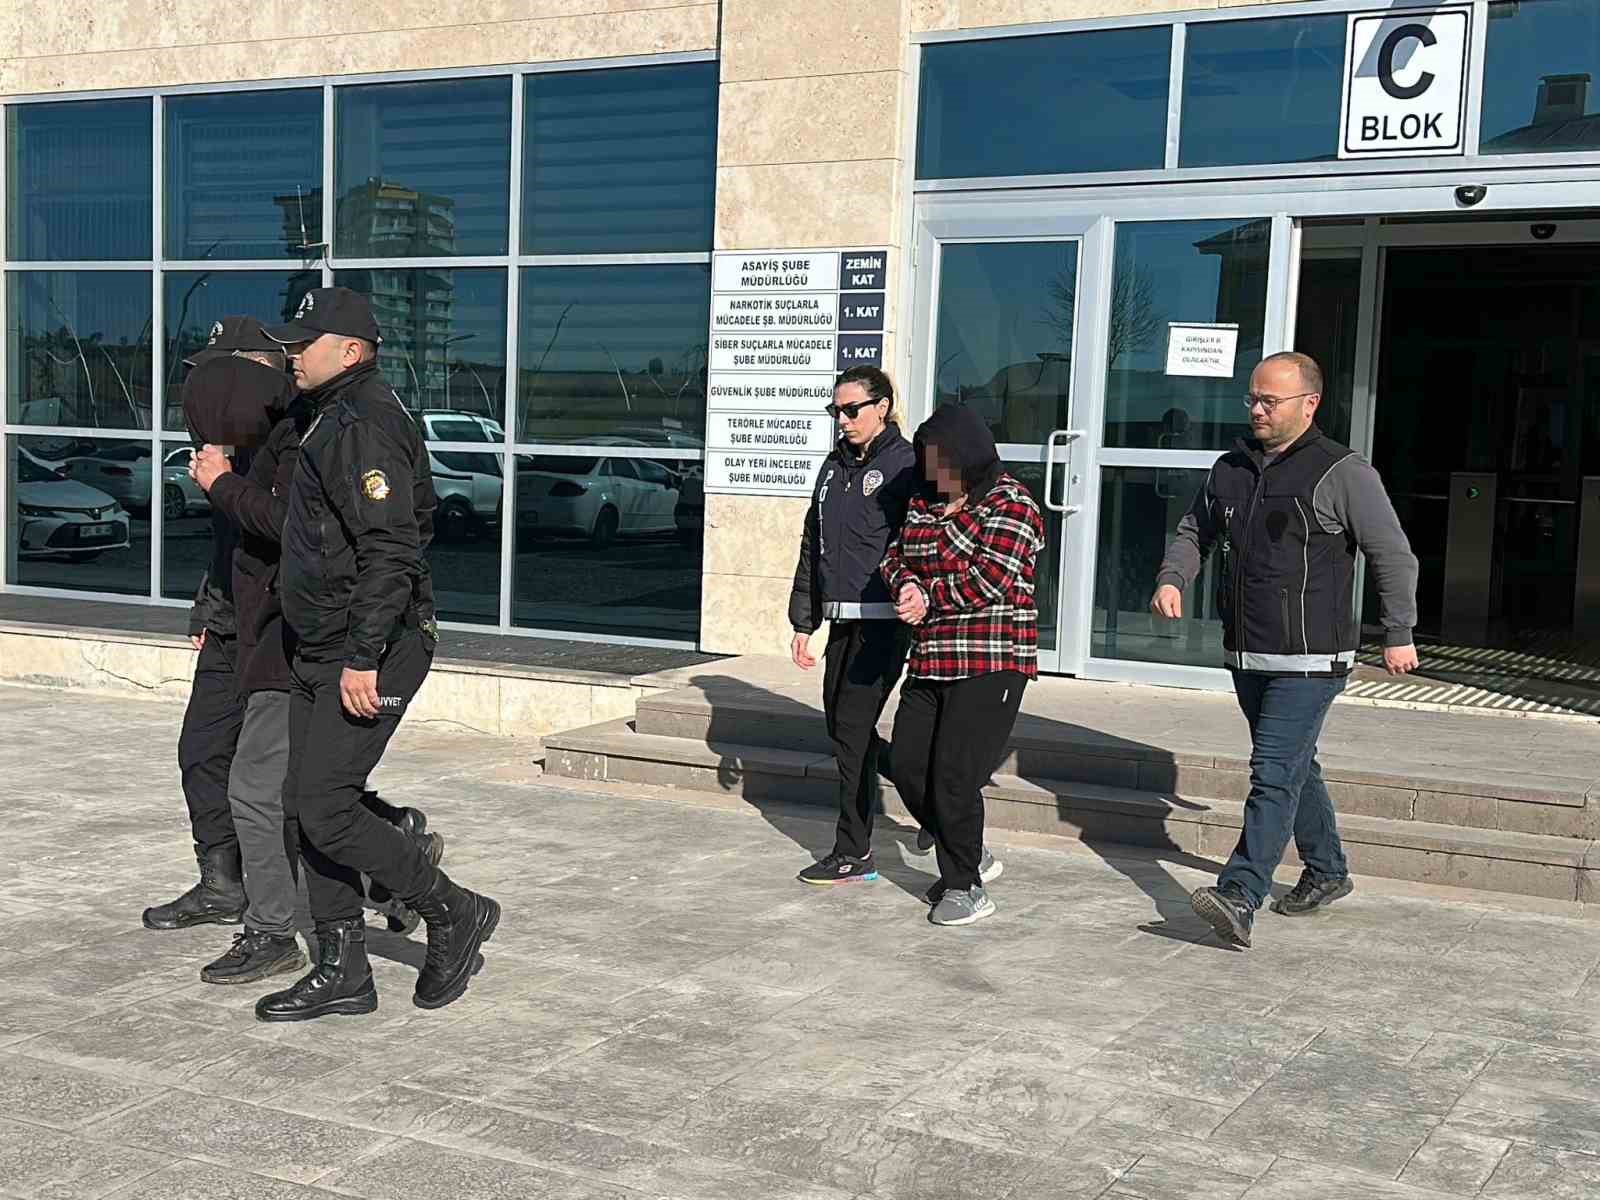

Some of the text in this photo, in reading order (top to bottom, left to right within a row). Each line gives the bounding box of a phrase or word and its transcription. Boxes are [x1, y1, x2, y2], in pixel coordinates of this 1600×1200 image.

[1378, 23, 1438, 100] C
[1361, 112, 1443, 141] BLOK
[742, 260, 811, 273] ASAYİŞ ŞUBE
[845, 256, 882, 270] ZEMİN
[741, 274, 808, 287] MÜDÜRLÜĞÜ
[852, 274, 875, 286] KAT
[730, 299, 819, 311] NARKOTİK SUÇLARLA
[844, 306, 880, 318] 1. KAT
[716, 313, 833, 327] MÜCADELE ŞB. MÜDÜRLÜĞÜ
[714, 339, 832, 351] SİBER SUÇLARLA MÜCADELE
[734, 353, 811, 366] ŞUBE MÜDÜRLÜĞÜ
[842, 347, 878, 359] 1. KAT
[710, 385, 833, 398] GÜVENLİK ŞUBE MÜDÜRLÜĞÜ
[728, 418, 812, 430] TERÖRLE MÜCADELE
[730, 433, 808, 445] ŞUBE MÜDÜRLÜĞÜ
[724, 457, 812, 470] OLAY YERİ İNCELEME
[729, 472, 806, 485] ŞUBE MÜDÜRLÜĞÜ
